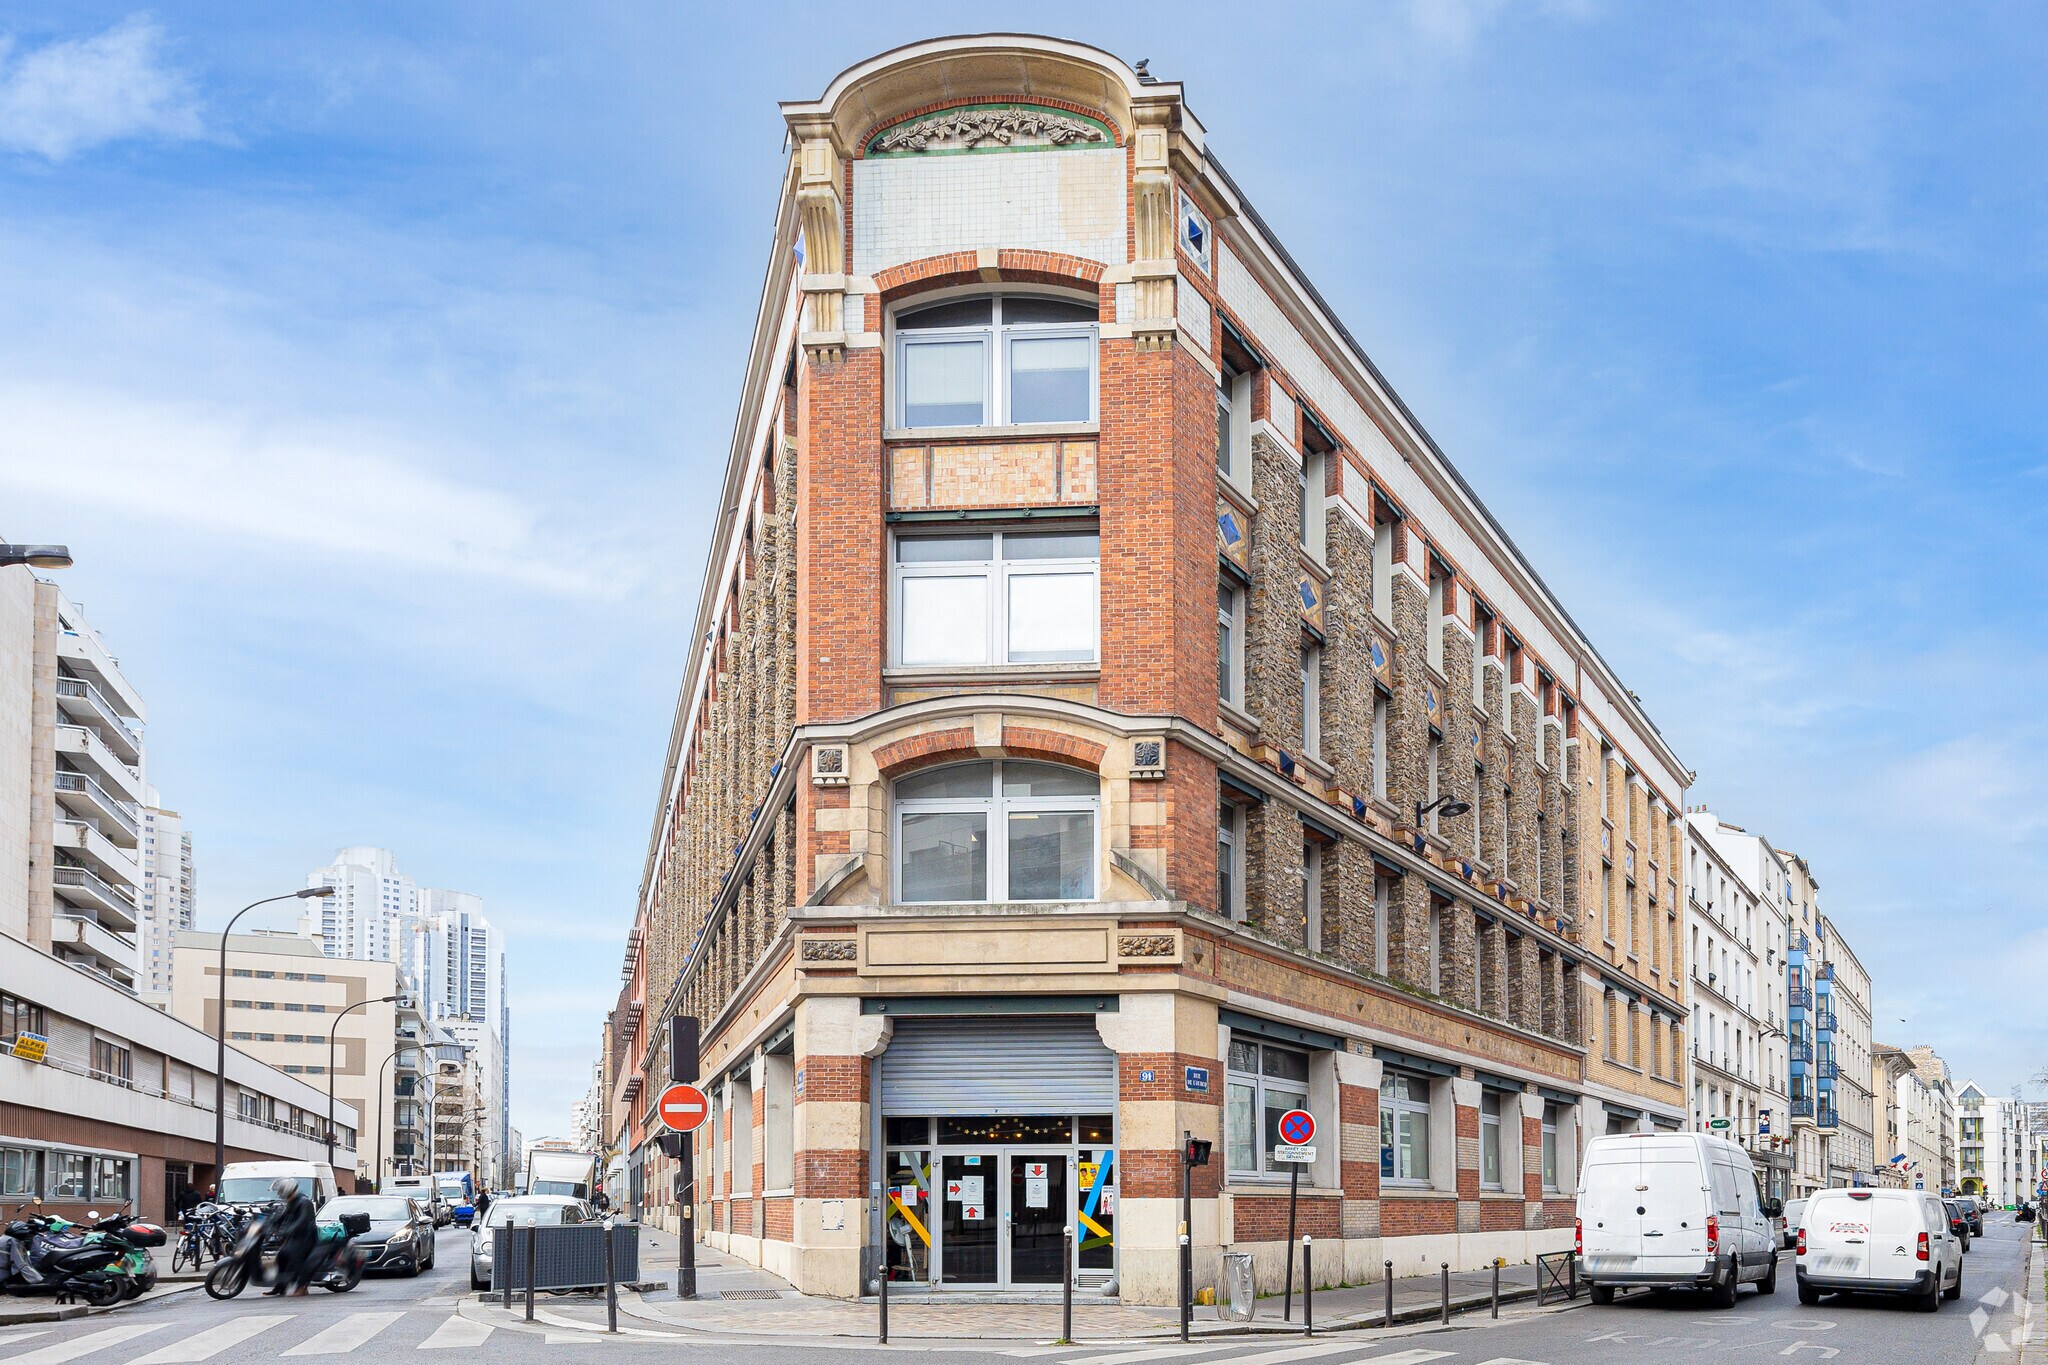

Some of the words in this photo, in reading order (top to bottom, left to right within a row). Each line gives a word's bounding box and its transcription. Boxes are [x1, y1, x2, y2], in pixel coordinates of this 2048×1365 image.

[27, 1033, 48, 1042] VENDRE
[20, 1039, 45, 1049] ALPHA
[1142, 1072, 1152, 1080] 91
